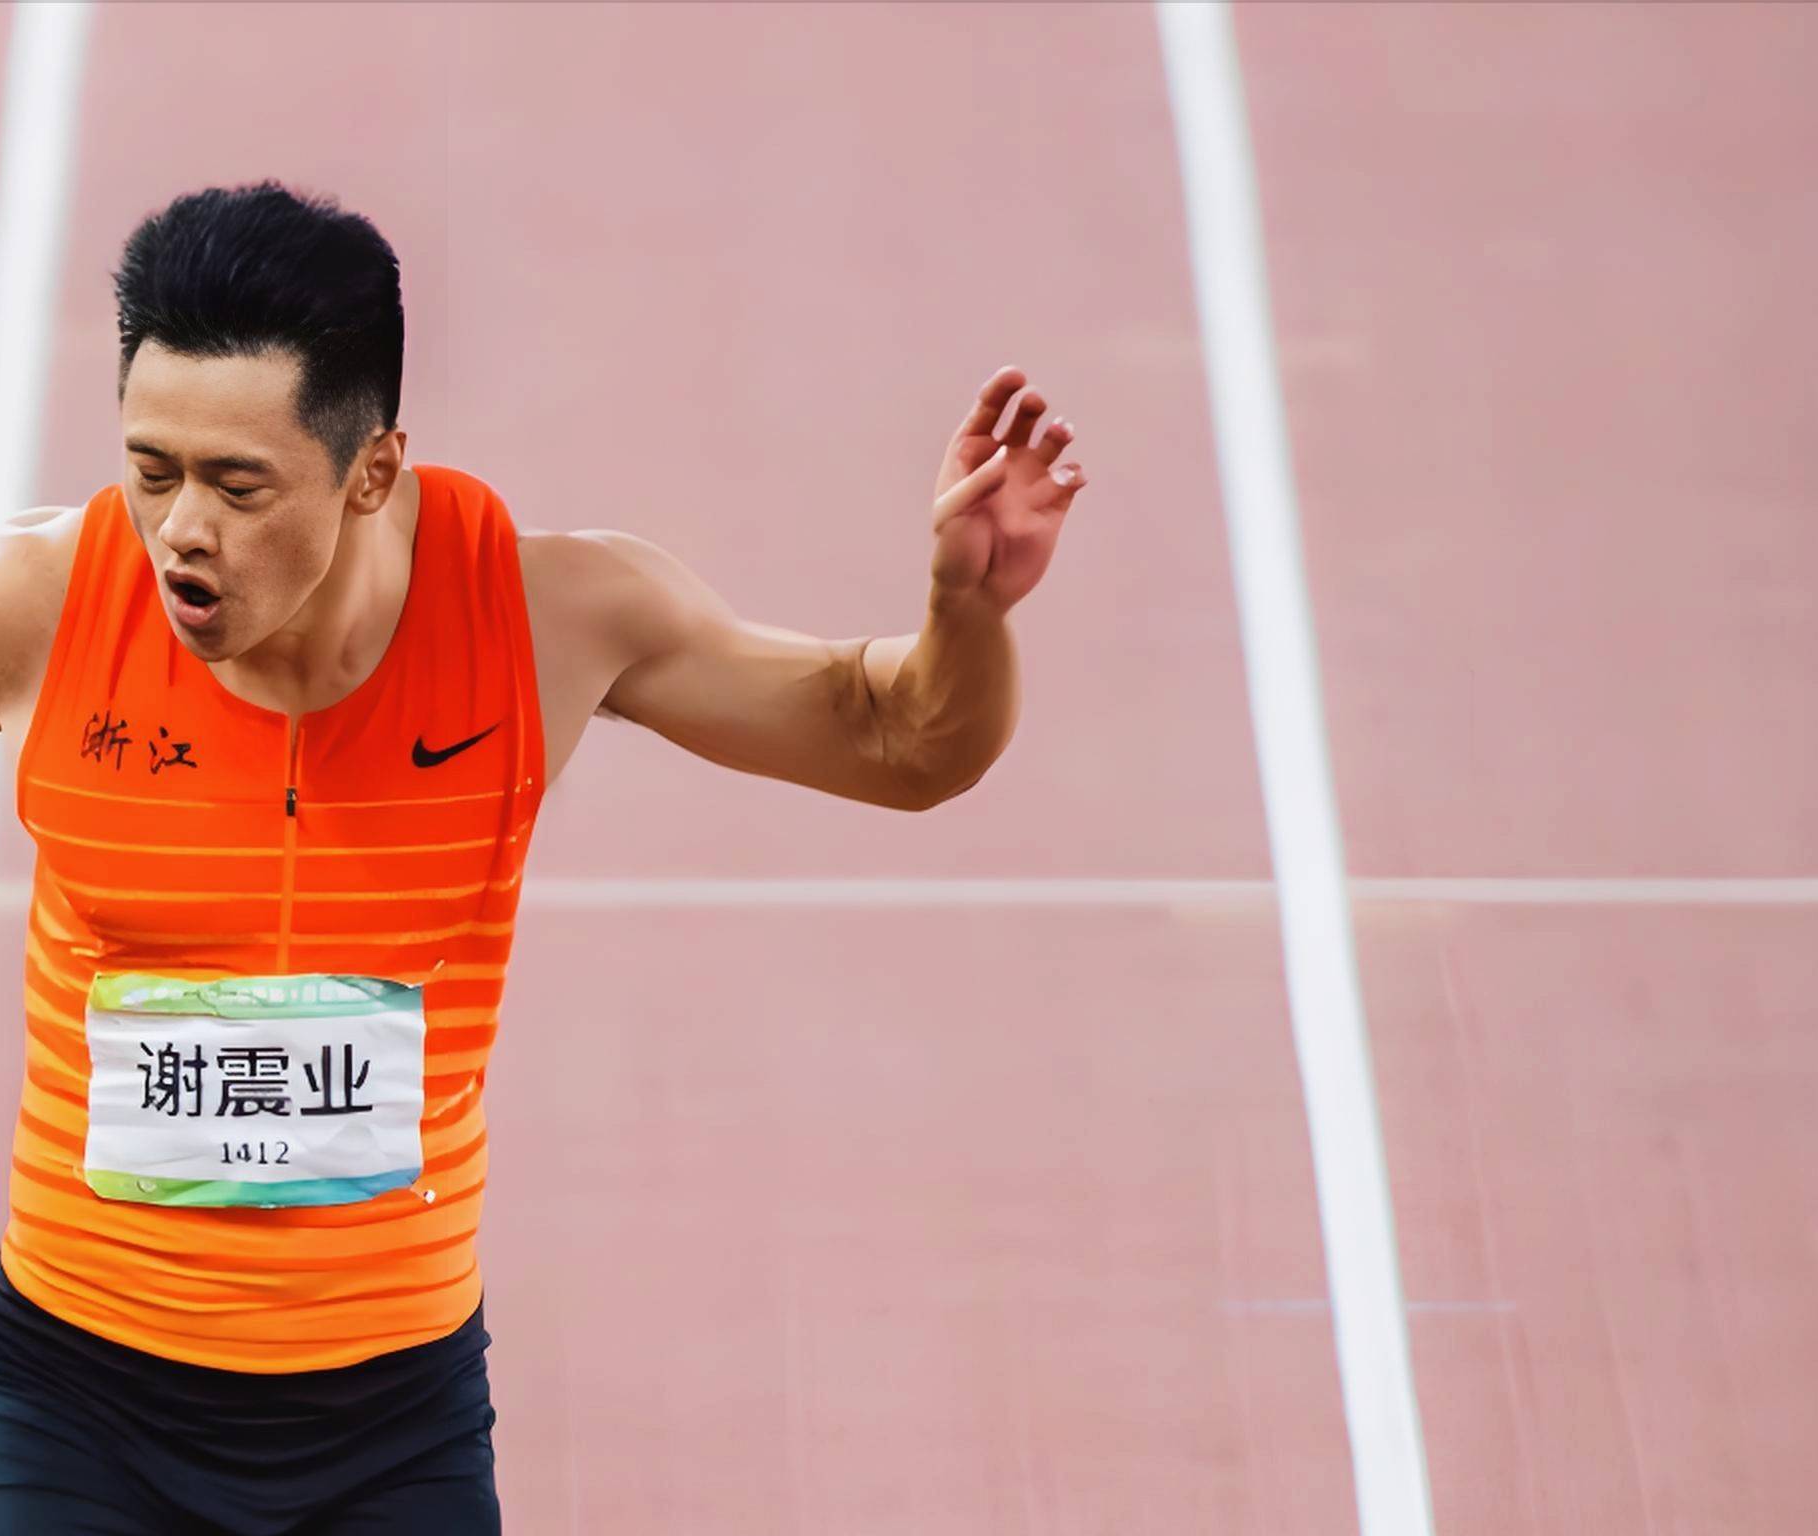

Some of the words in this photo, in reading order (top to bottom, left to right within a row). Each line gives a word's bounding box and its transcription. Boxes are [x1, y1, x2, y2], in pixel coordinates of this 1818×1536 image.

[81, 710, 198, 775] 浙江
[137, 1041, 374, 1118] 谢震业
[219, 1140, 291, 1166] 1412
